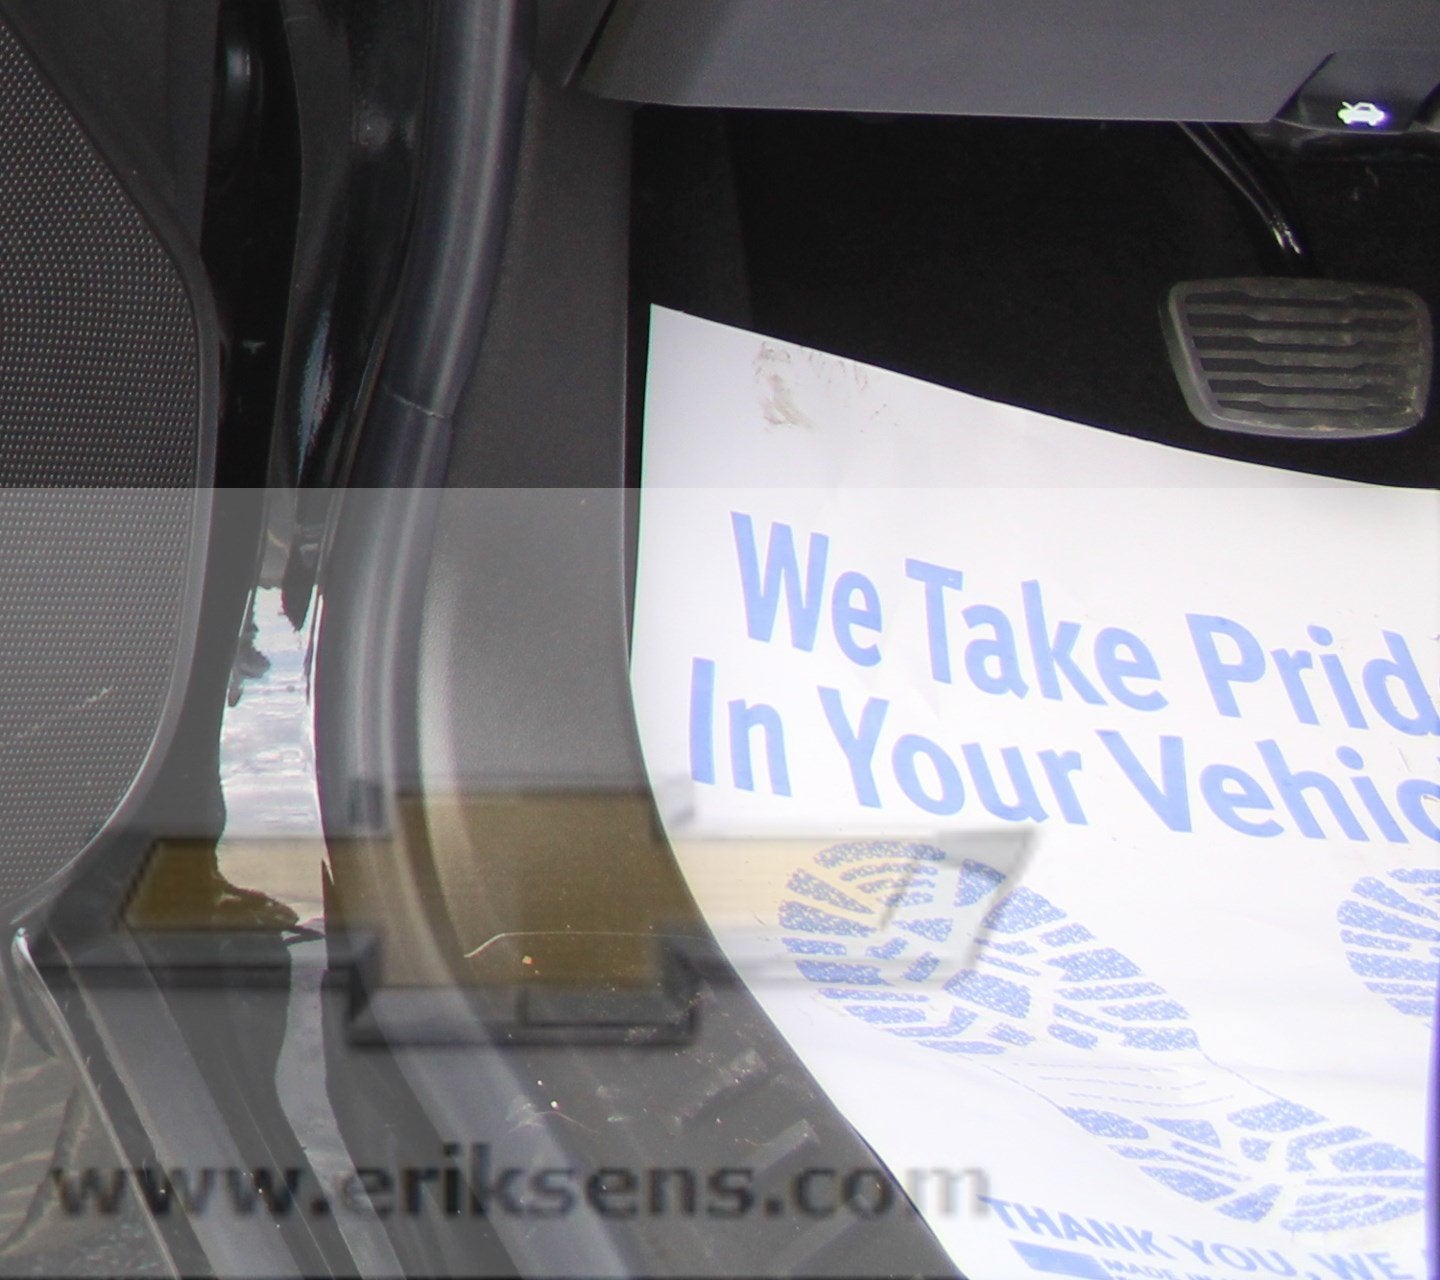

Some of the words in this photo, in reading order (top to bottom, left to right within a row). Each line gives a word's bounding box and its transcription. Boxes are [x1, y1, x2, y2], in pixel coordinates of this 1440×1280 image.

[730, 510, 883, 668] We
[905, 557, 1170, 713] Take
[1184, 612, 1440, 737] Prid
[689, 656, 792, 798] In
[817, 685, 1089, 826] Your
[1095, 728, 1440, 845] Vehic
[976, 1193, 1178, 1259] THANK
